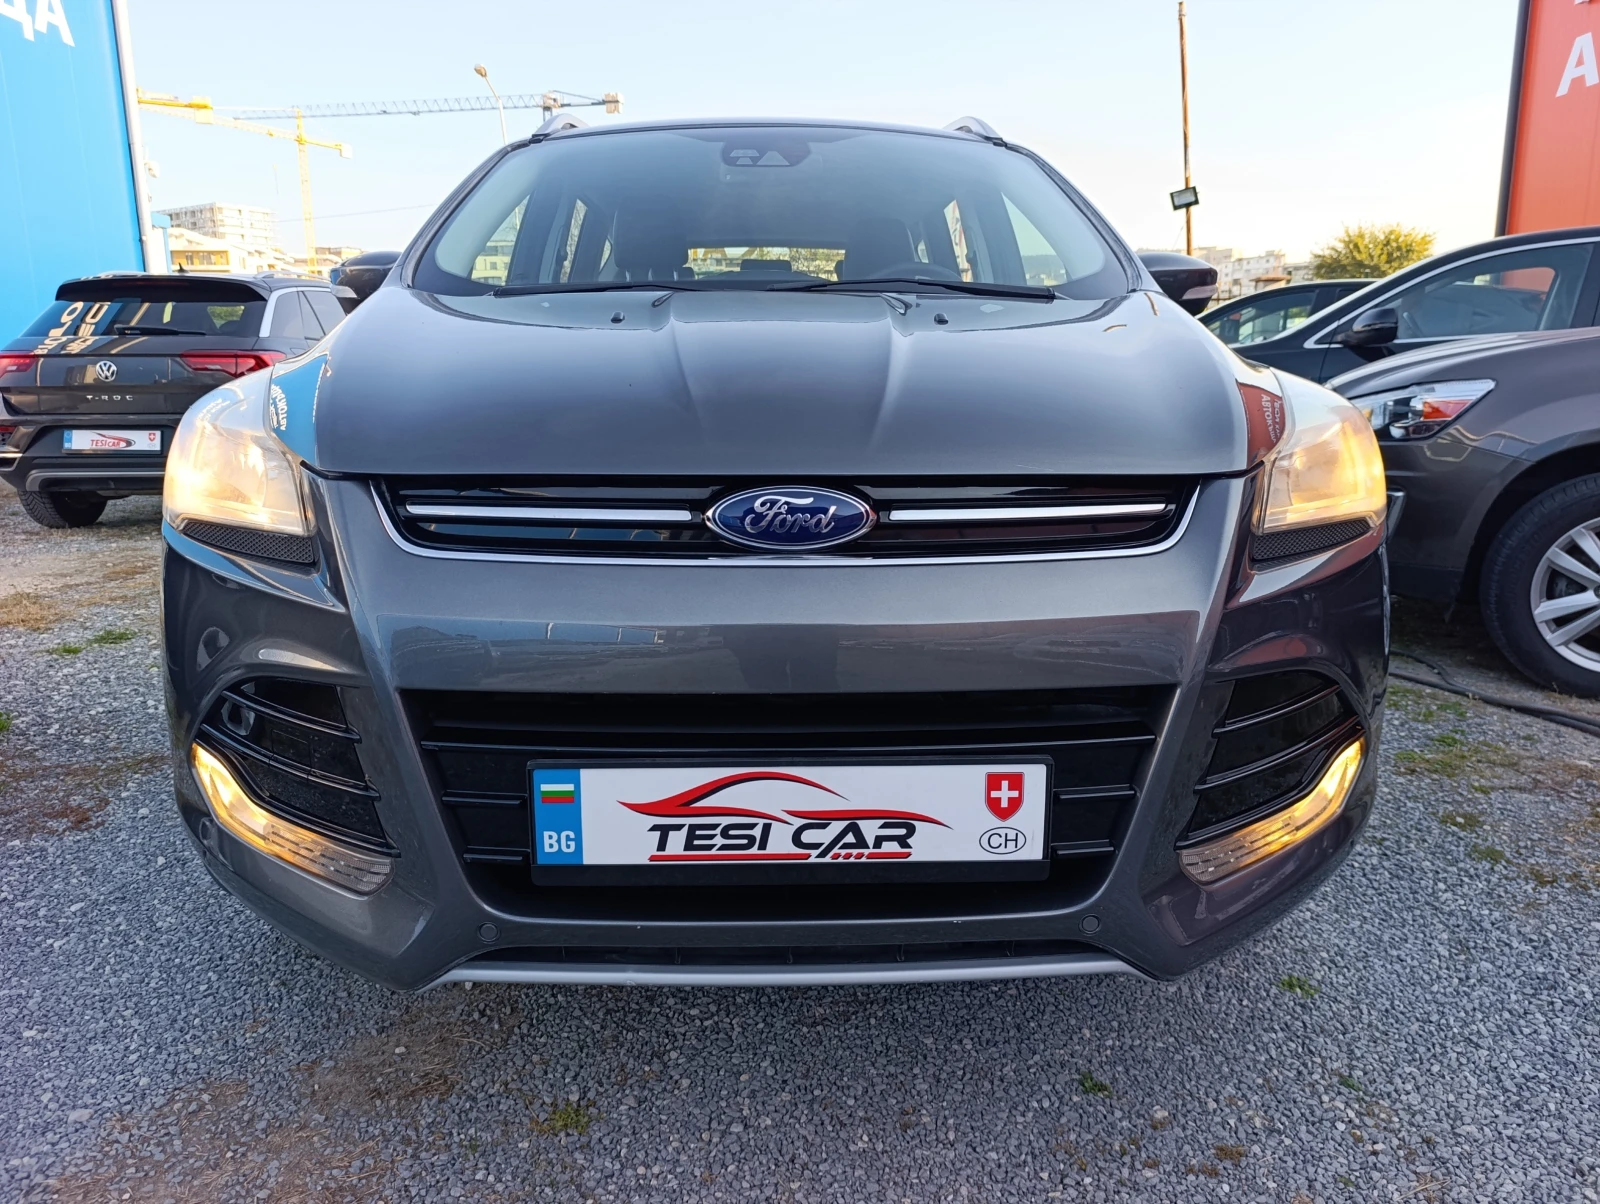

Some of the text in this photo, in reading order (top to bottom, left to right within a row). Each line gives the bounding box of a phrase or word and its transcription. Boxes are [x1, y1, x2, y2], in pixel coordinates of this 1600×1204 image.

[744, 495, 837, 534] Ford
[543, 830, 576, 853] BG
[647, 821, 917, 859] TESI CAR
[987, 832, 1019, 850] CH
